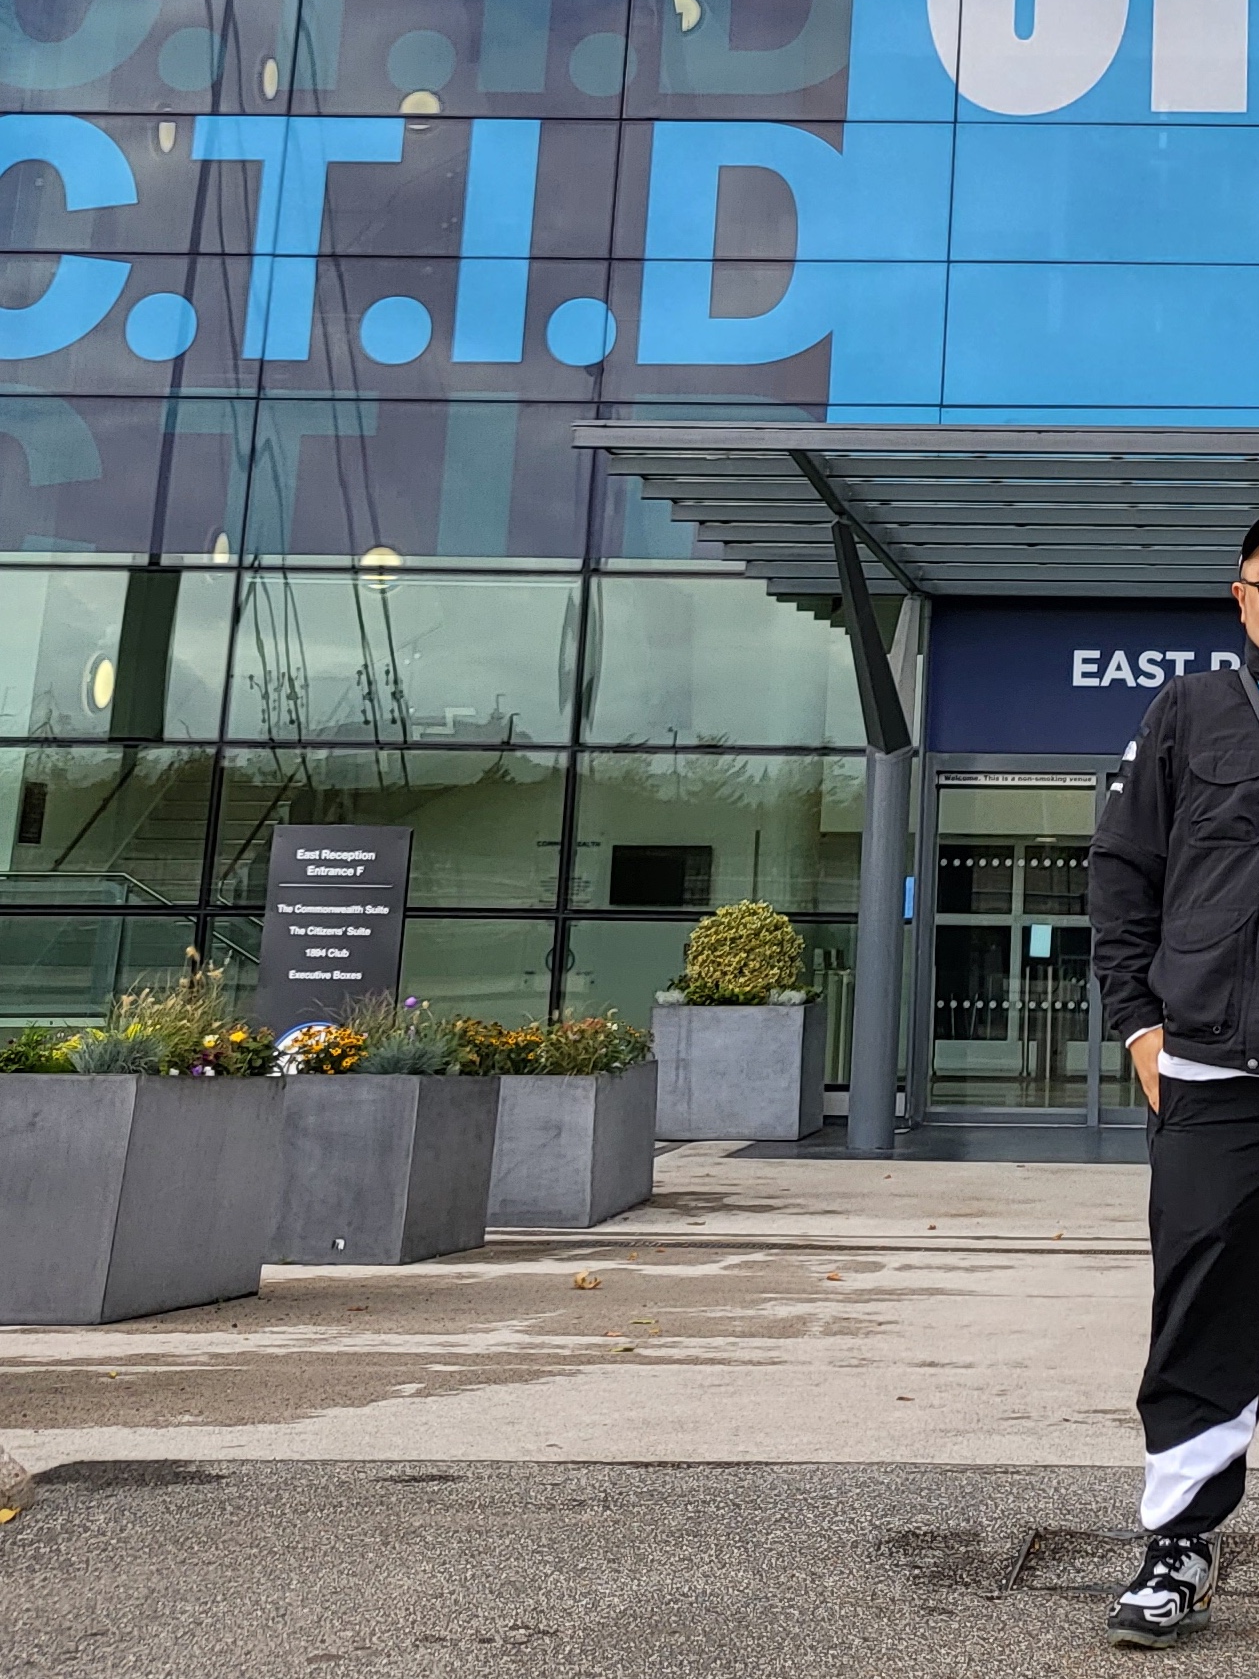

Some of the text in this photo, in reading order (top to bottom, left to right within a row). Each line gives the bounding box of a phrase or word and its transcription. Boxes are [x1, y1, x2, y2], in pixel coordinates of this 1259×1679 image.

[1072, 650, 1195, 688] EAST
[1018, 775, 1067, 783] non-smoking
[296, 849, 376, 862] East Reception
[306, 865, 364, 877] Entrance F
[277, 904, 389, 914] The Commonwealth Suite
[289, 926, 305, 935] The
[347, 927, 371, 936] Suite
[305, 948, 349, 958] 1894 Club
[289, 970, 362, 980] Executive Boxes
